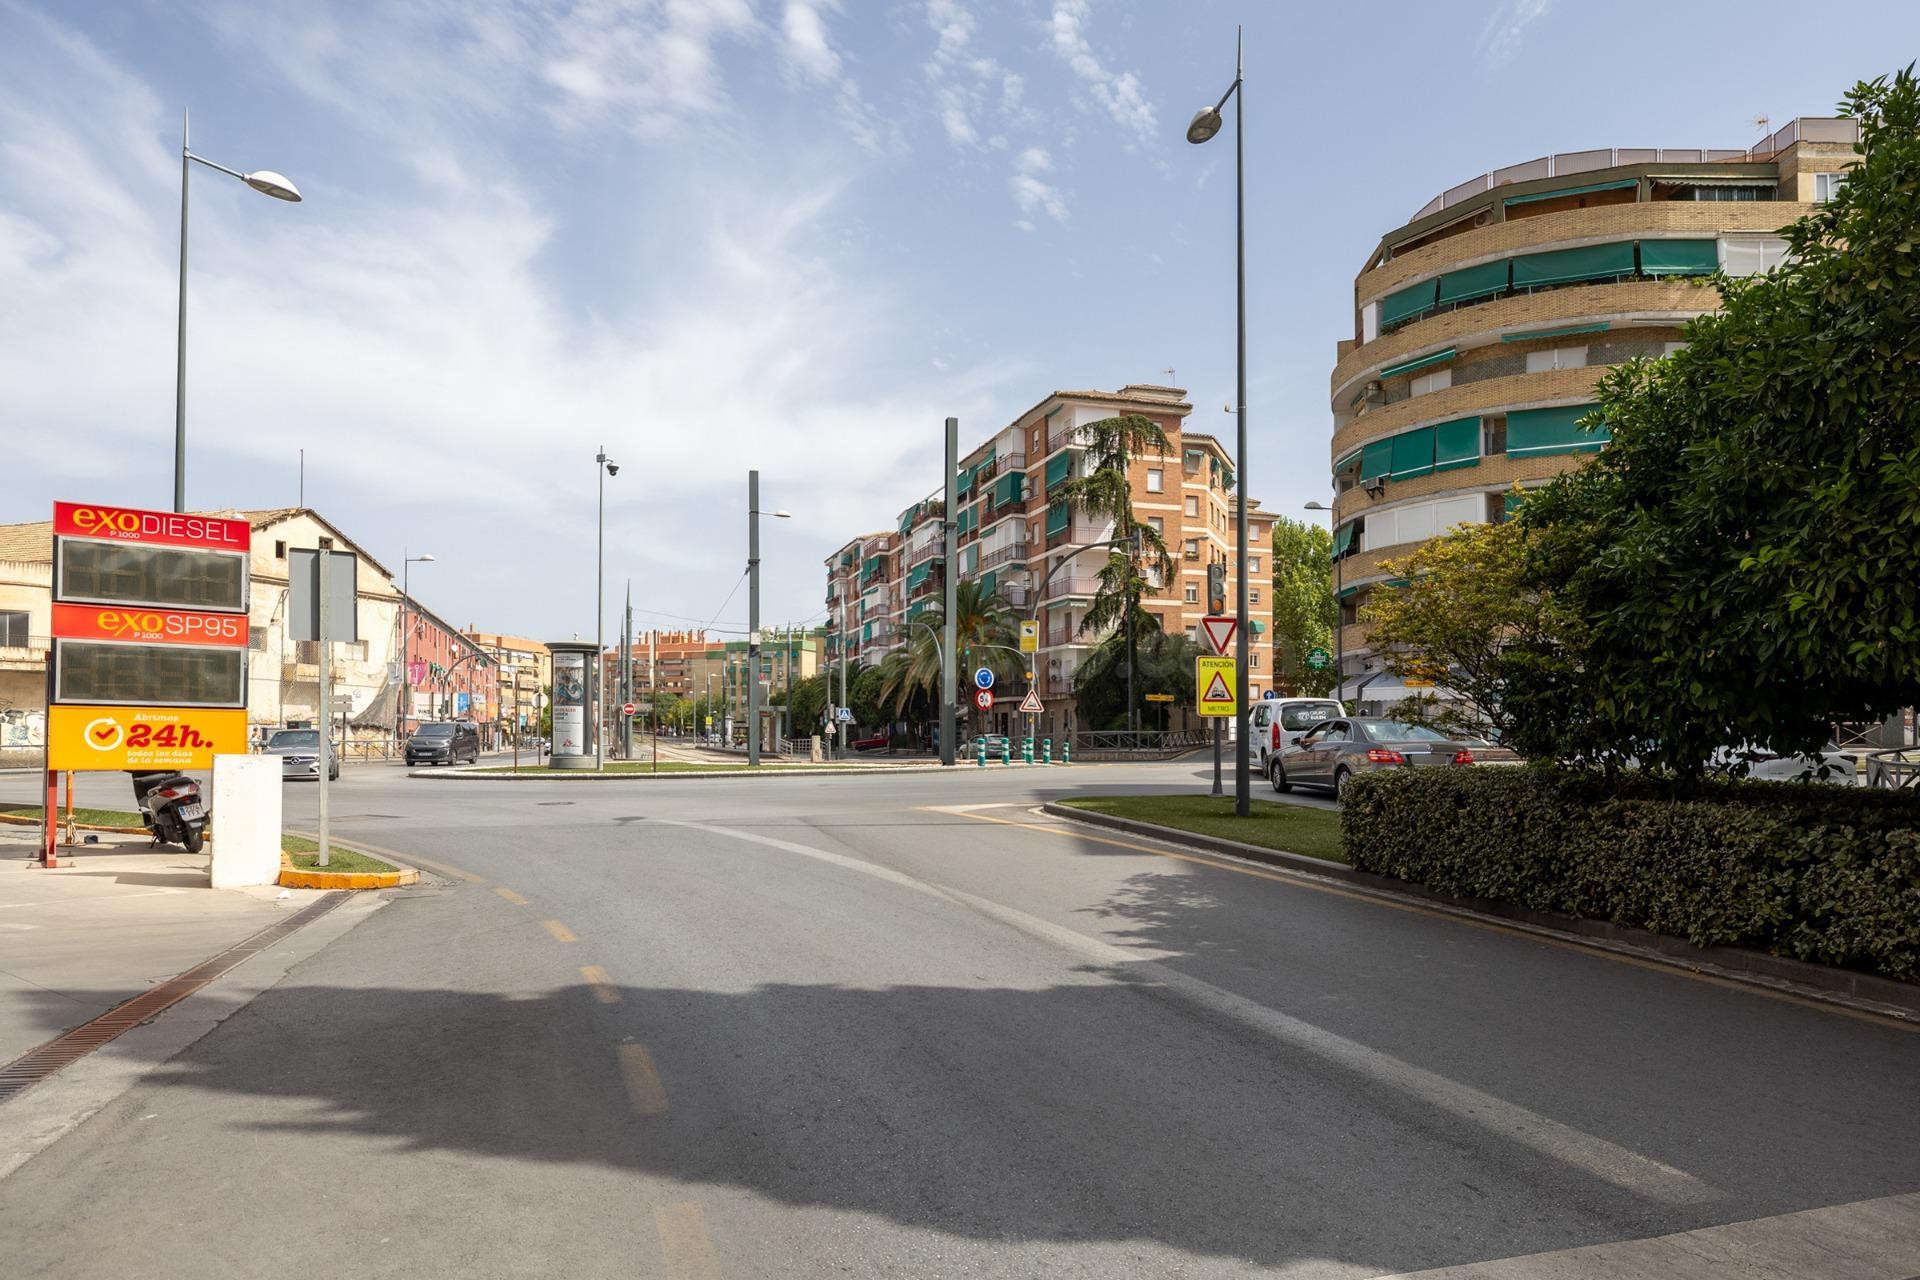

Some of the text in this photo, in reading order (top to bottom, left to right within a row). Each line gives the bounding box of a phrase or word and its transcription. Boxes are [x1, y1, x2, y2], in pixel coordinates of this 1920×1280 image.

[118, 531, 140, 539] 1000
[1201, 660, 1234, 668] ATENCIÓN
[126, 723, 213, 749] 24h.
